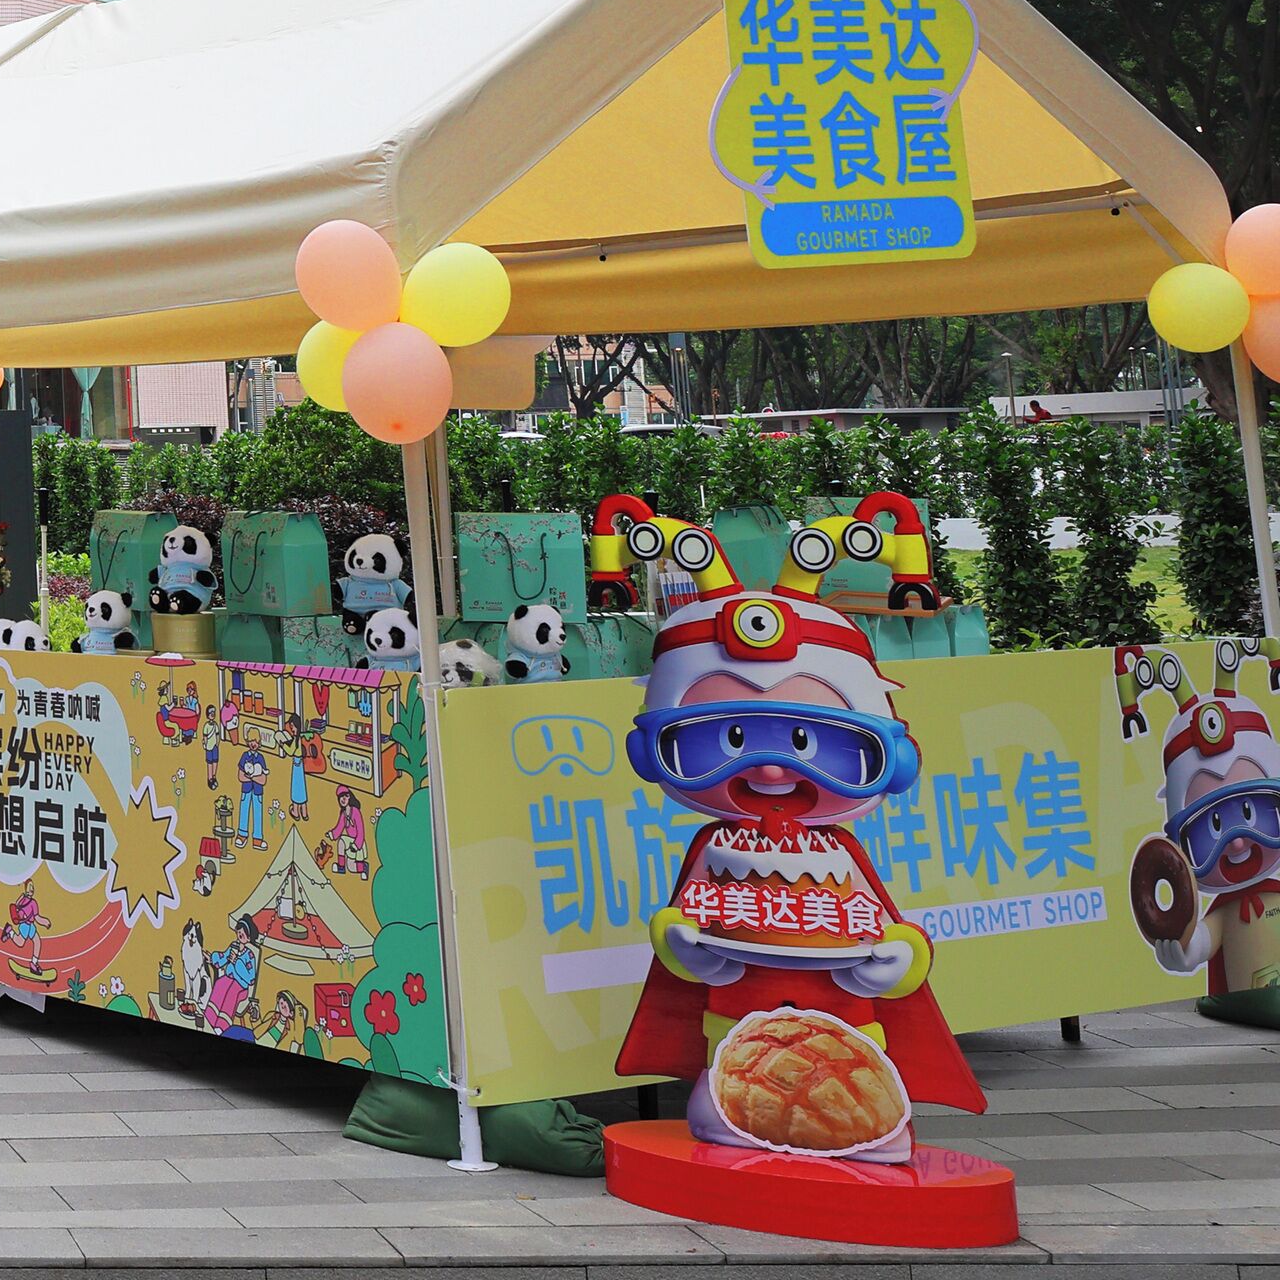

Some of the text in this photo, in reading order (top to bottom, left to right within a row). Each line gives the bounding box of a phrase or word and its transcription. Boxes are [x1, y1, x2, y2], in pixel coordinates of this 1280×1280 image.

[749, 91, 958, 189] 美食屋
[821, 202, 895, 223] RAMADA
[796, 225, 932, 251] GOURMET SHOP
[17, 689, 101, 722] 为青春呐喊
[44, 732, 95, 755] HAPPY
[44, 752, 92, 774] EVERY
[44, 773, 74, 792] DAY
[684, 883, 881, 936] 华美达美食
[923, 891, 1103, 940] GOURMET SHOP
